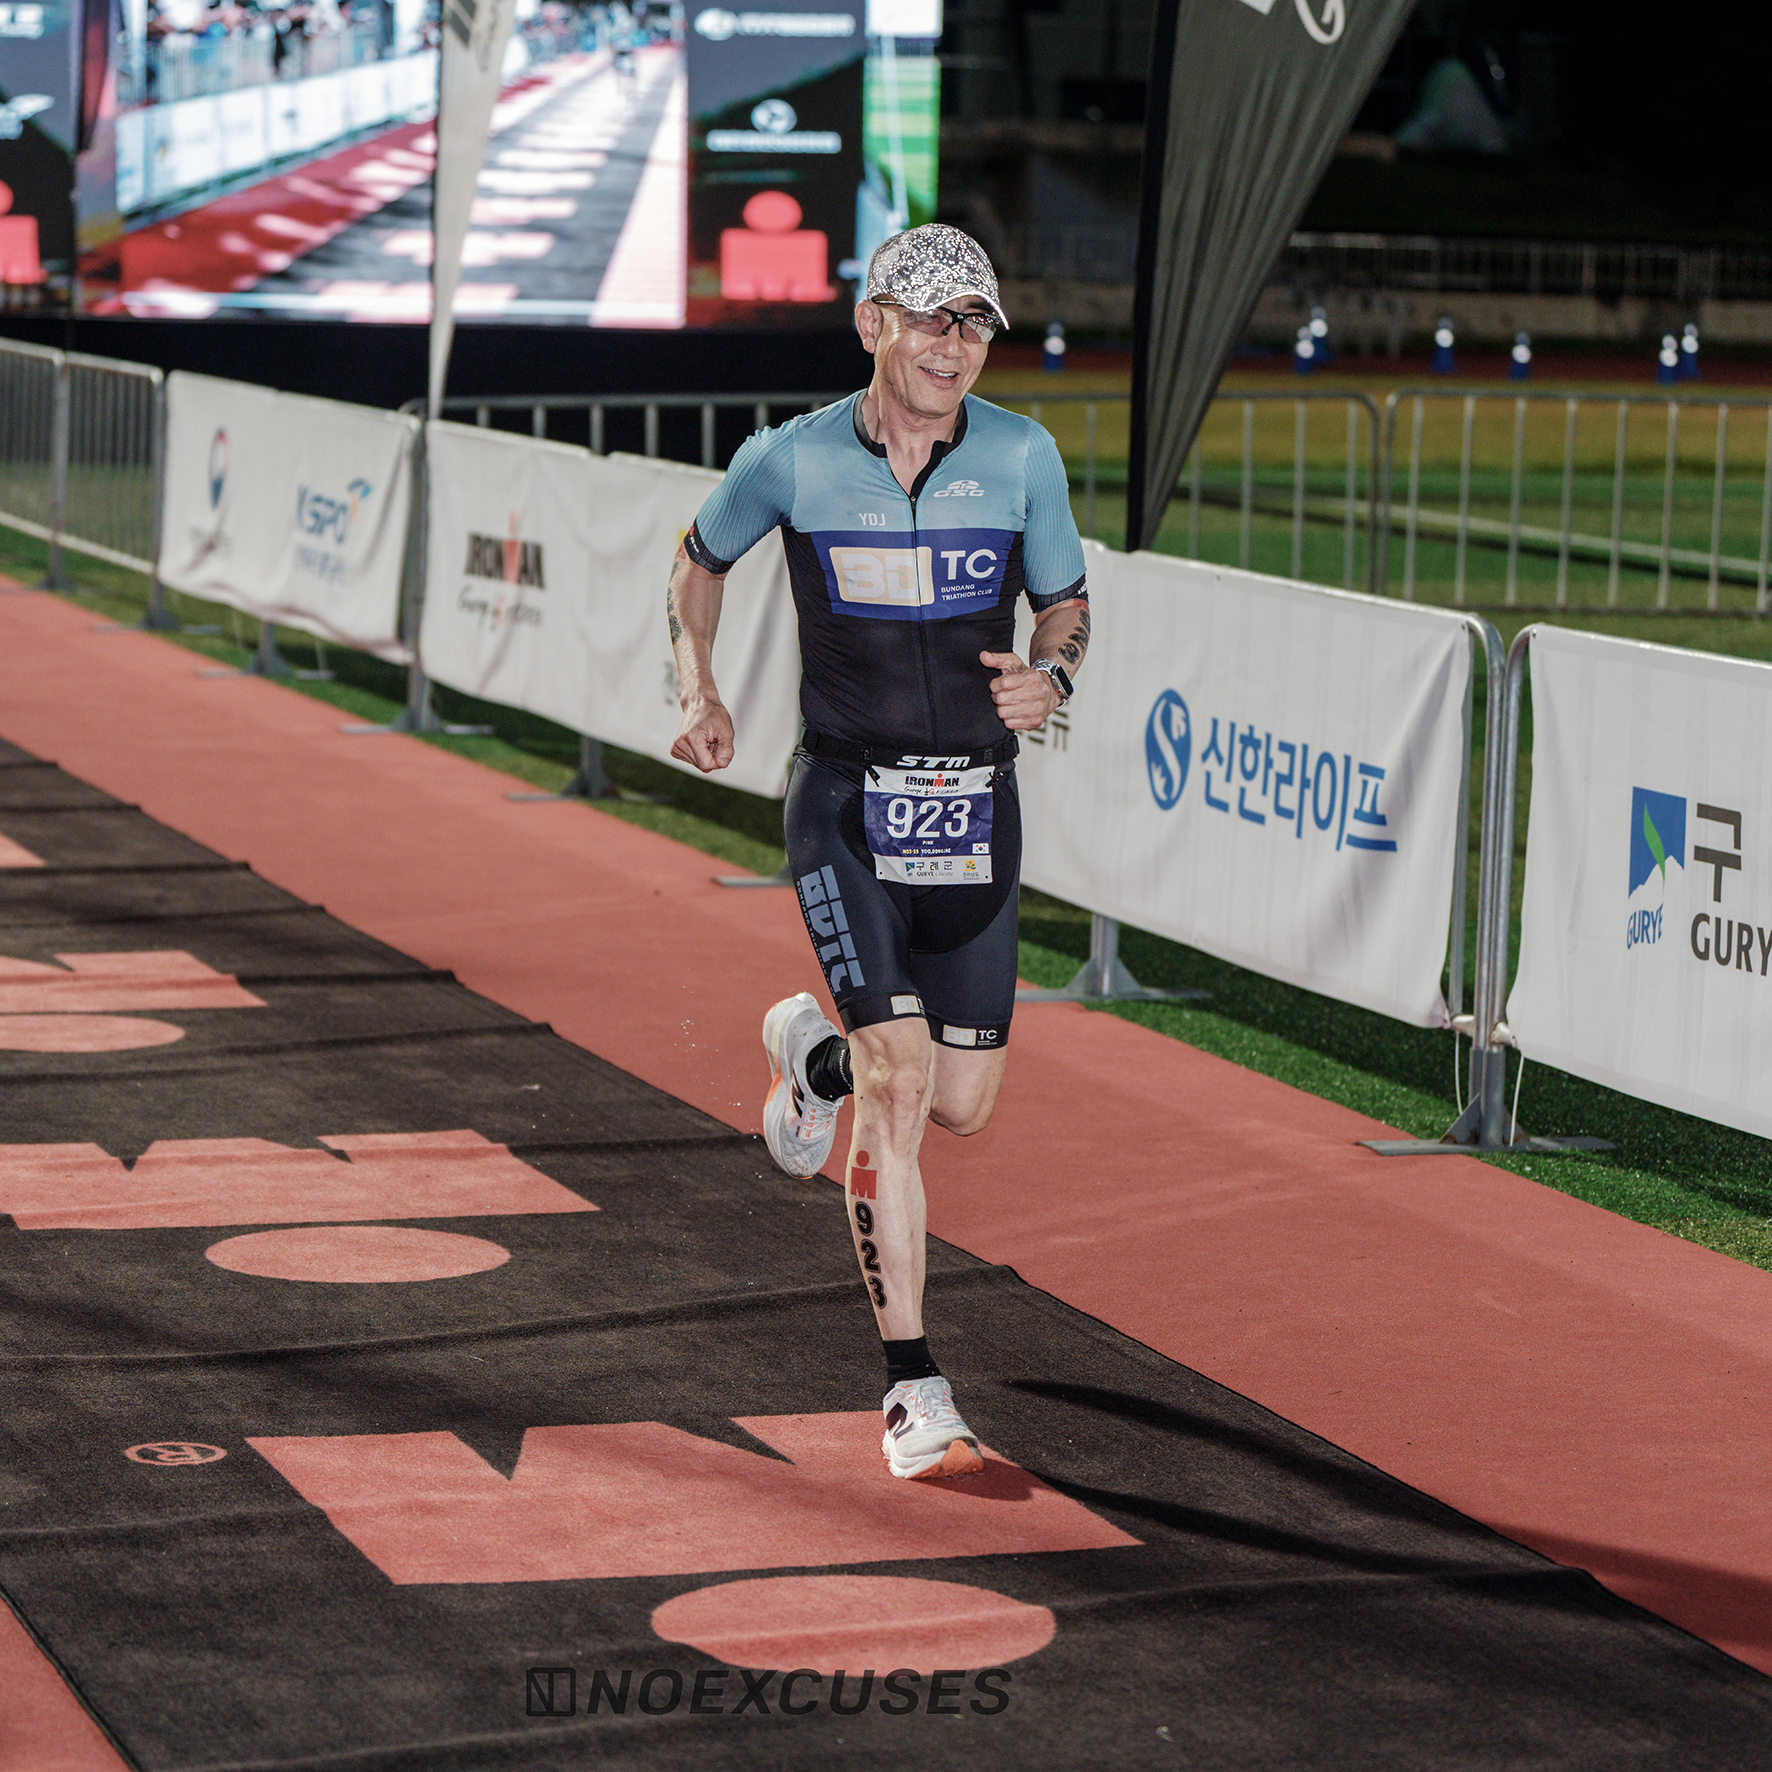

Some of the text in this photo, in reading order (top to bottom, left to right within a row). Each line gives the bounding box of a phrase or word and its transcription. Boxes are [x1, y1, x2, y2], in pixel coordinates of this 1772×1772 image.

[933, 489, 985, 498] GSG
[858, 513, 886, 527] YDJ
[941, 549, 998, 580] TC
[941, 583, 976, 593] BUNDANG
[977, 588, 993, 596] CLUB
[896, 755, 971, 769] STM
[905, 773, 960, 787] IRONMAN
[1201, 716, 1398, 852] 신한라이프
[886, 798, 972, 839] 923
[1693, 803, 1743, 903] 구
[1626, 902, 1664, 951] GURYE
[979, 1030, 998, 1040] TC
[855, 1201, 887, 1310] 923
